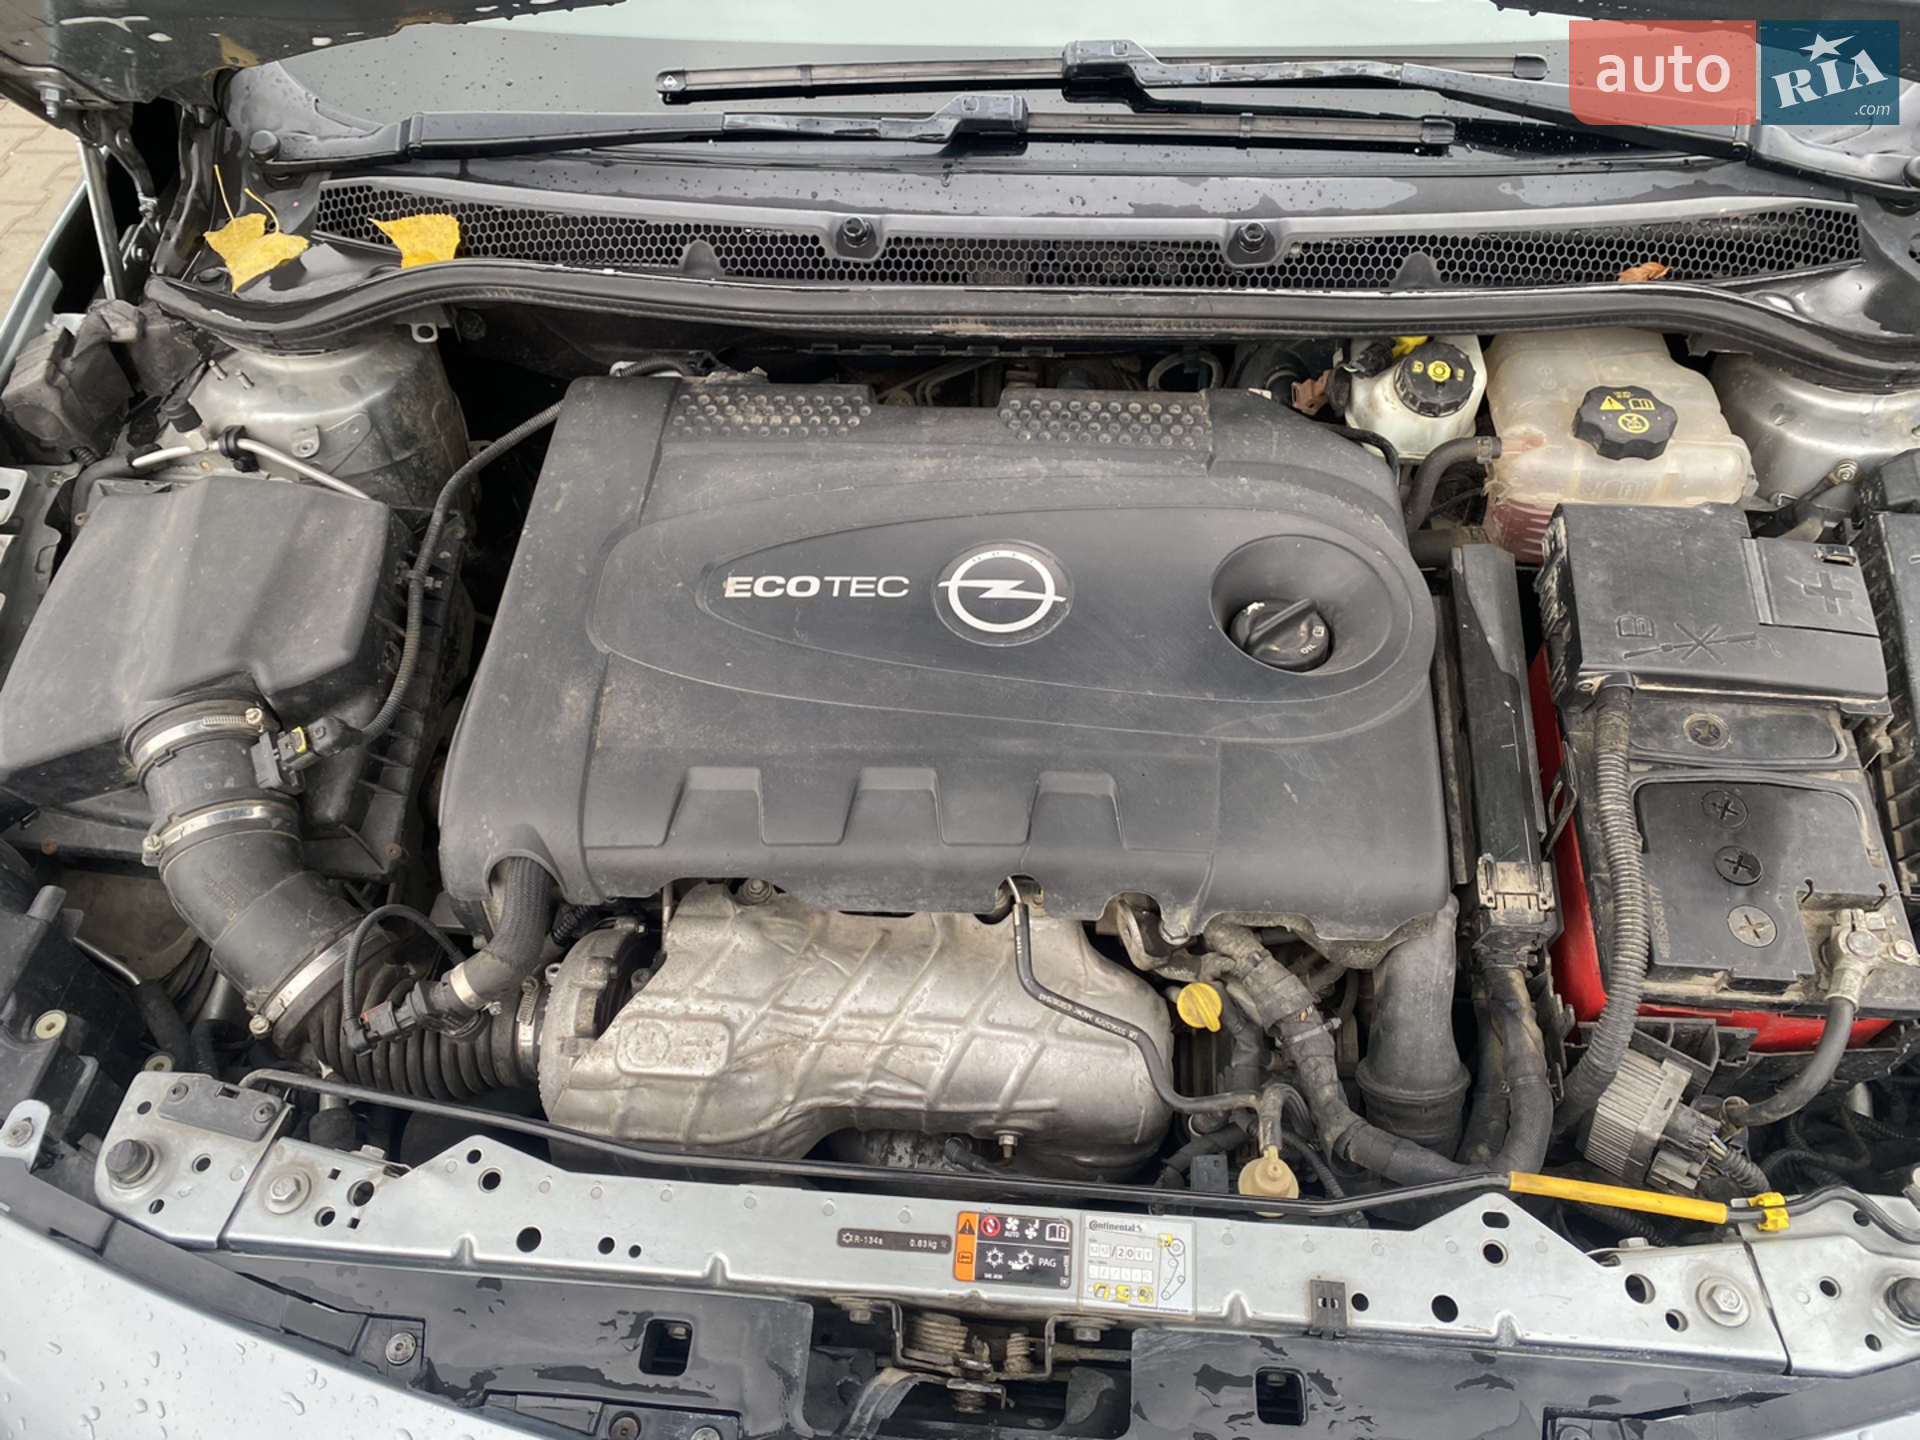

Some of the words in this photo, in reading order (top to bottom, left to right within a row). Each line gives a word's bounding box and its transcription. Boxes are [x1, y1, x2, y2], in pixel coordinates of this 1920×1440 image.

[724, 575, 910, 598] ECOTEC
[1089, 1220, 1136, 1232] Continental
[1004, 1230, 1020, 1239] AUTO
[1038, 1257, 1057, 1268] PAG
